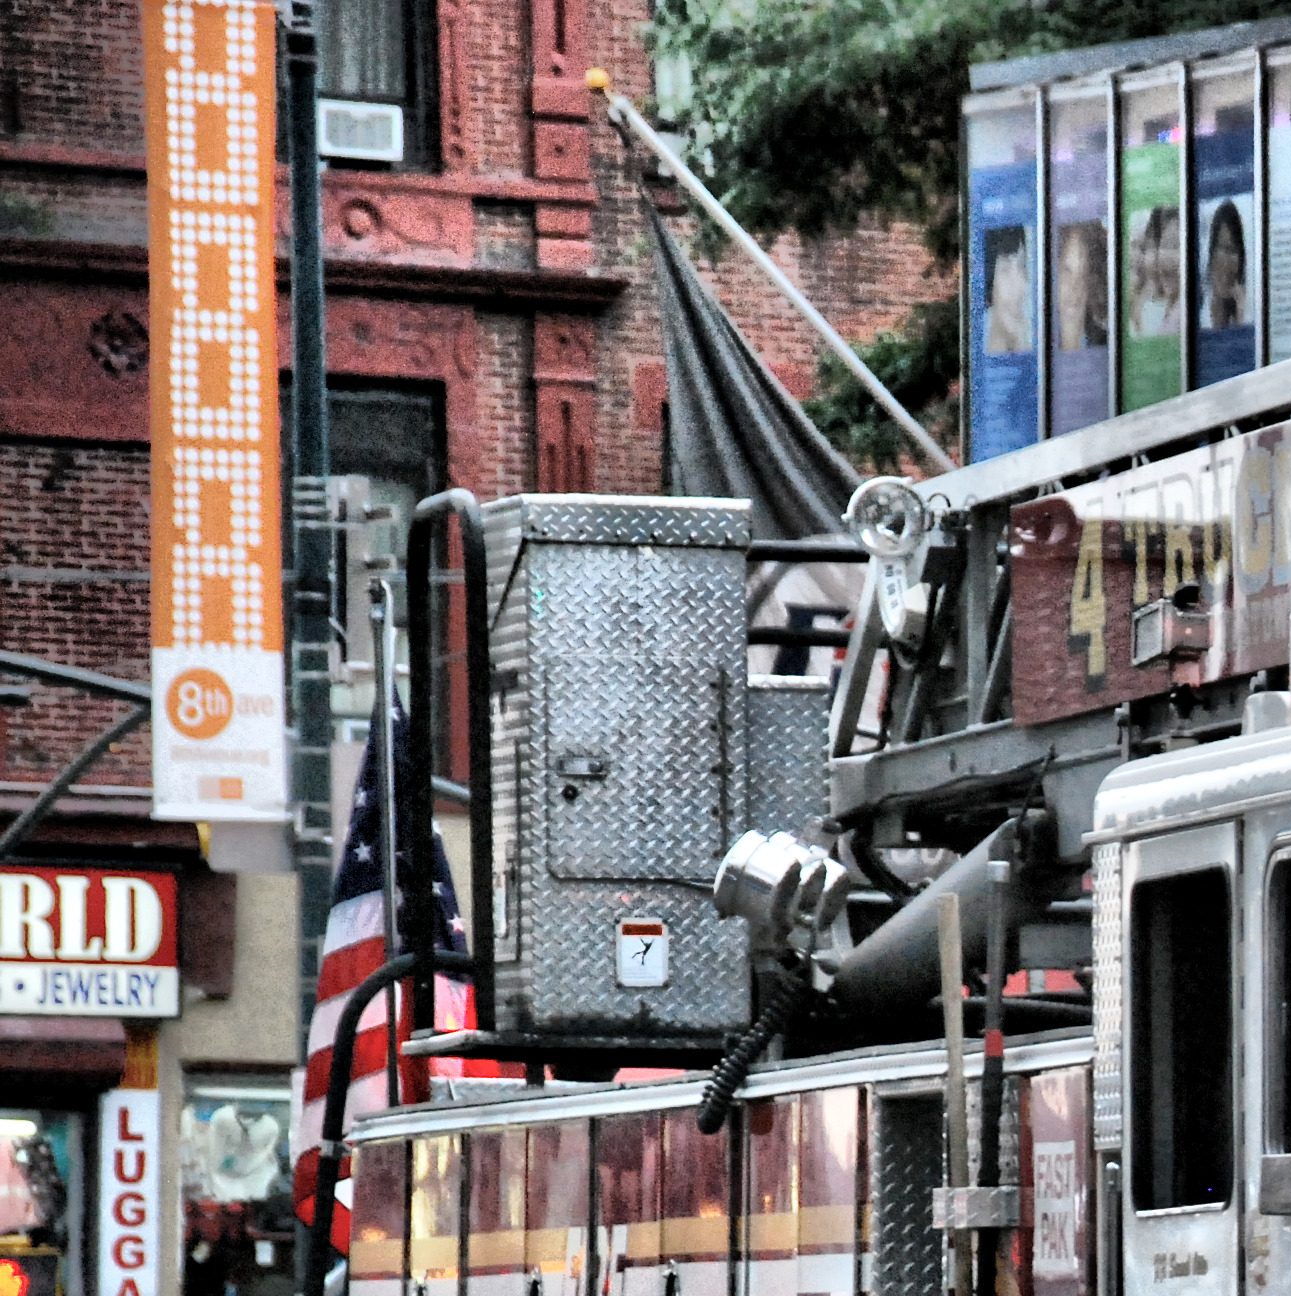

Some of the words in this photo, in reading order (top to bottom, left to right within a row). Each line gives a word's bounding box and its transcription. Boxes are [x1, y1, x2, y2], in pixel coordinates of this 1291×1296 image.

[1067, 497, 1106, 691] 4
[177, 680, 230, 728] 8th
[0, 872, 164, 963] RLD
[37, 967, 160, 1006] JEWELRY
[1036, 1153, 1074, 1200] FAST
[1041, 1210, 1070, 1261] PAK
